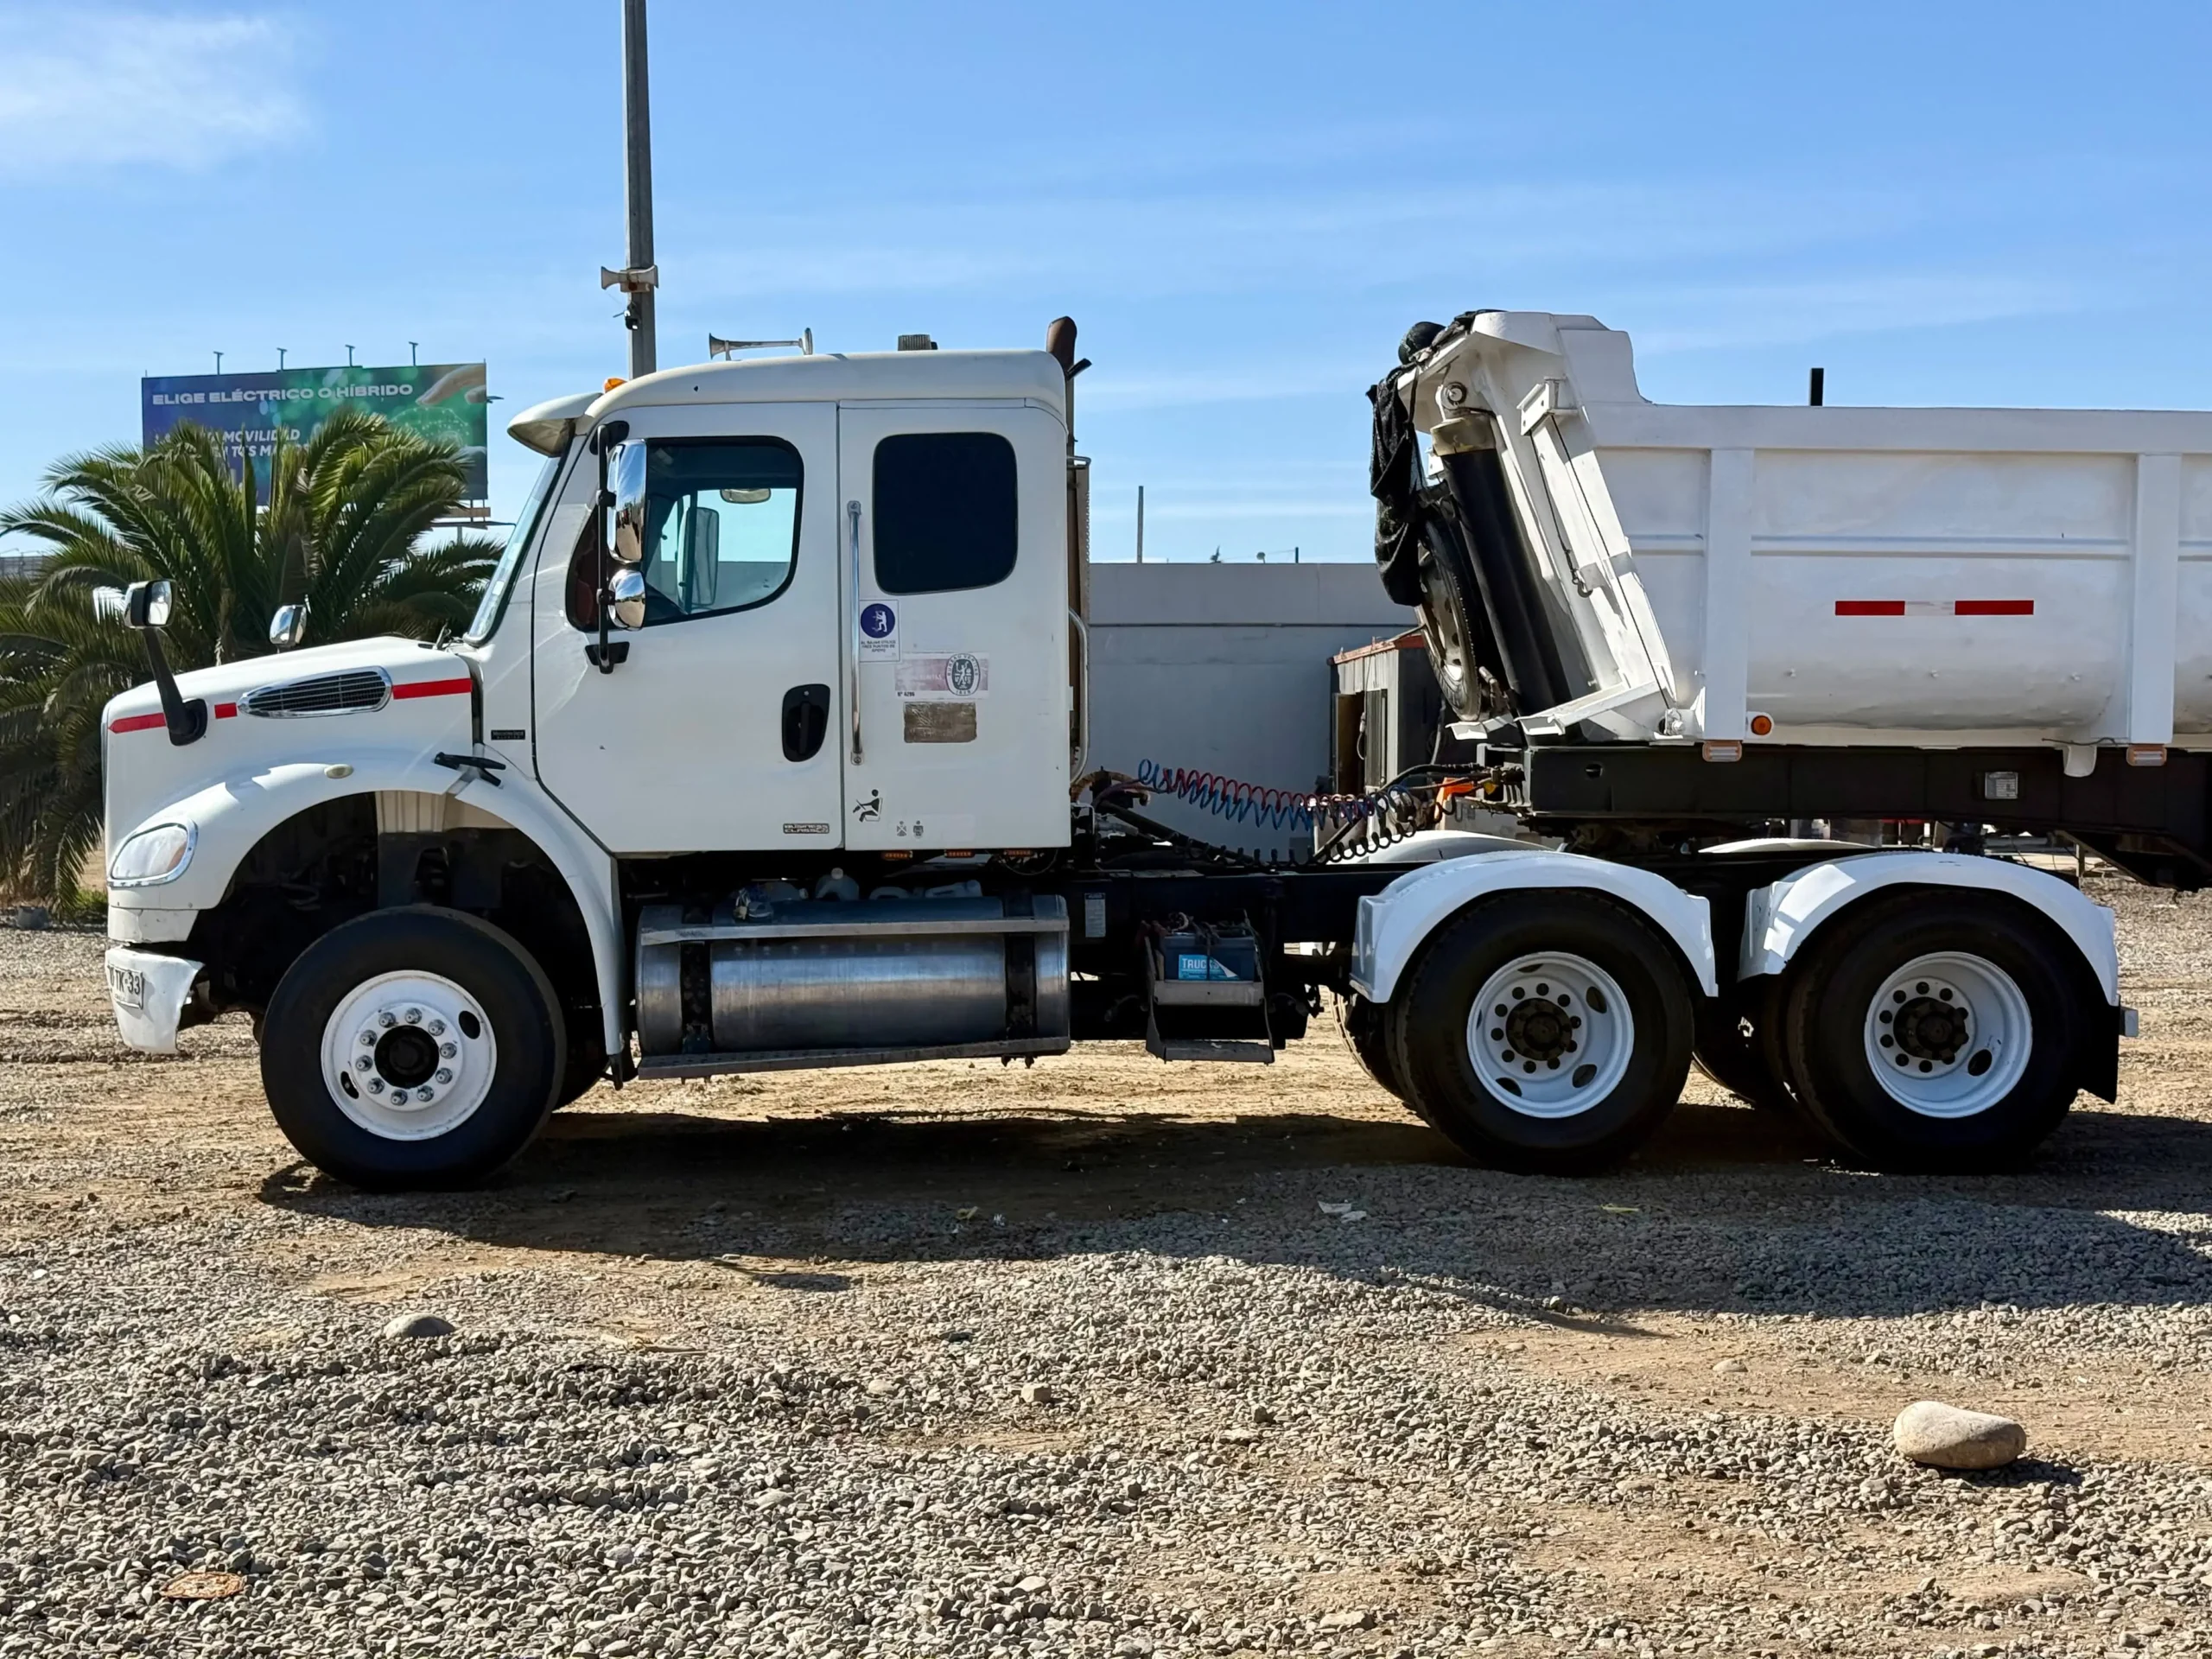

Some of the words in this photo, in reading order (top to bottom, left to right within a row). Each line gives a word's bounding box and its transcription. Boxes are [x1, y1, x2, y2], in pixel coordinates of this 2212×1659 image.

[152, 392, 206, 405] ELIGE
[209, 388, 314, 404] ELÉCTRICO
[318, 387, 332, 398] O
[336, 384, 413, 397] HÍBRIDO
